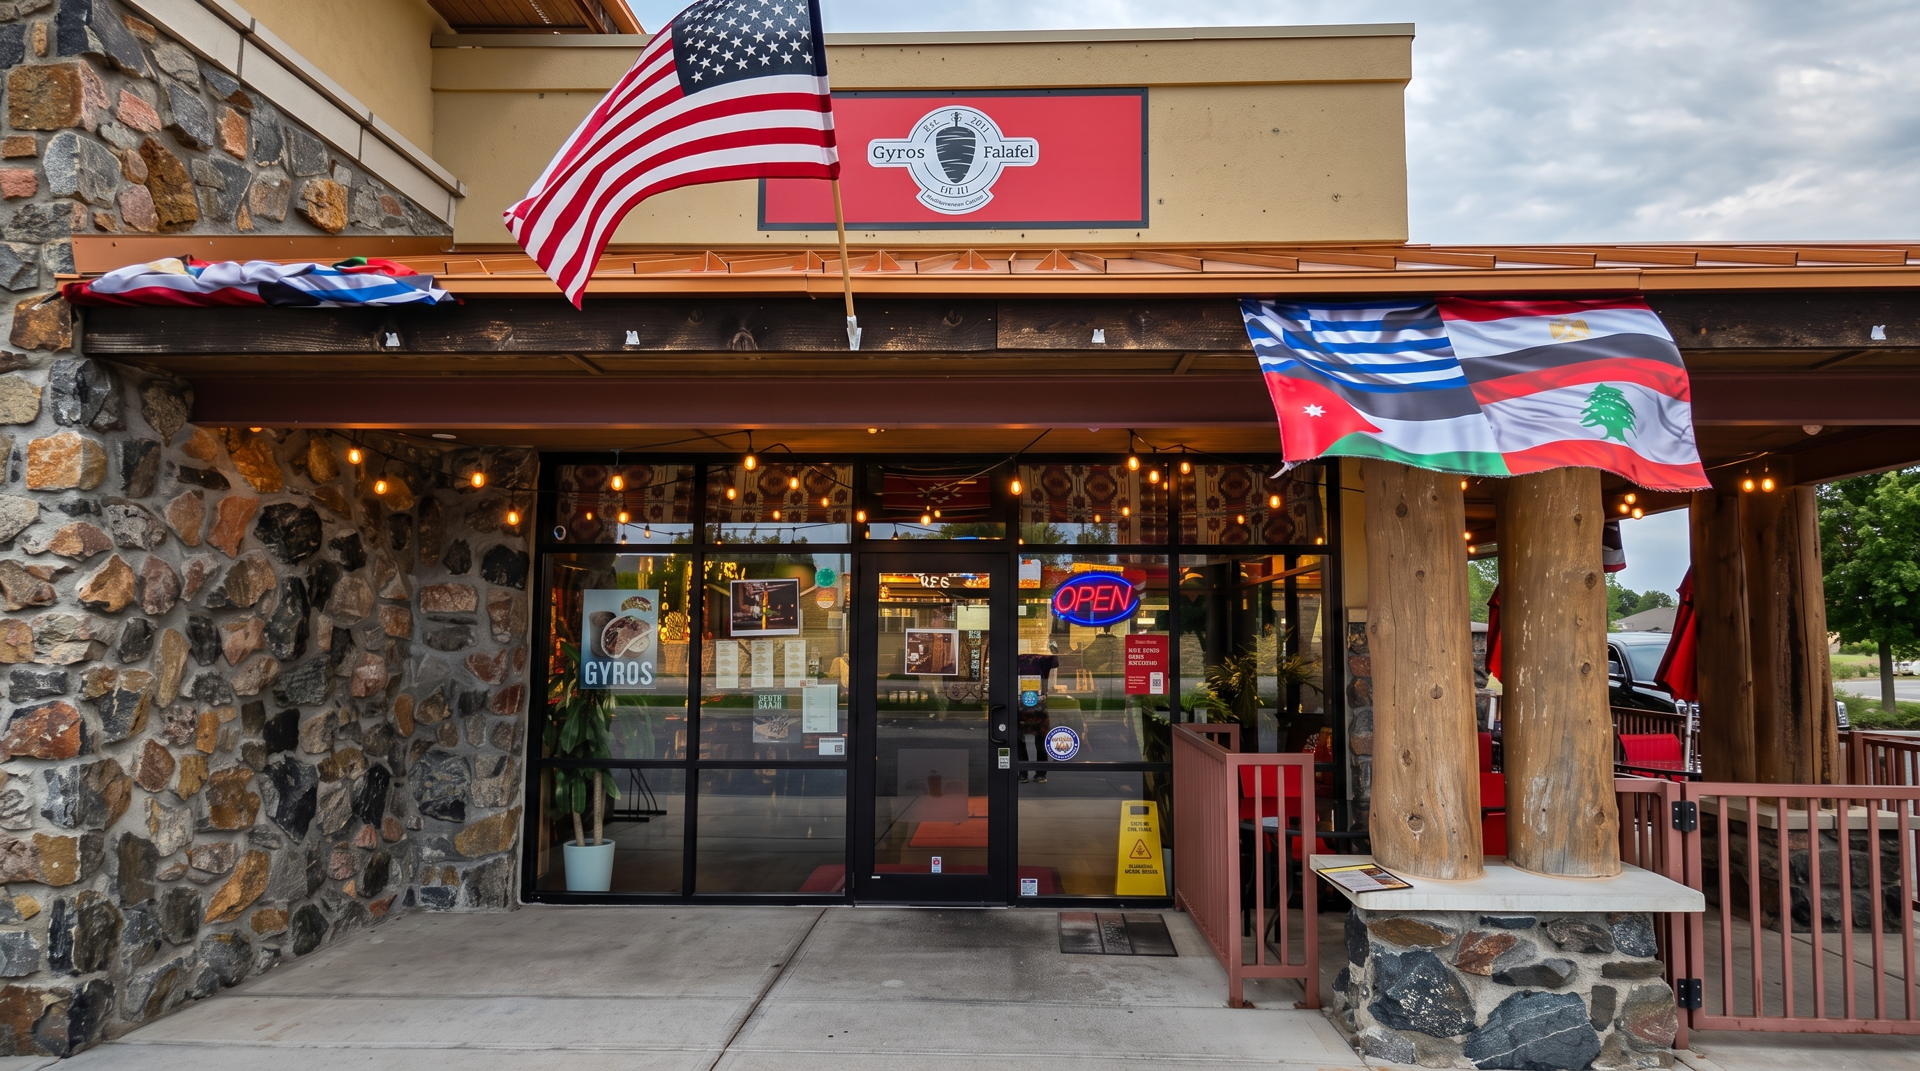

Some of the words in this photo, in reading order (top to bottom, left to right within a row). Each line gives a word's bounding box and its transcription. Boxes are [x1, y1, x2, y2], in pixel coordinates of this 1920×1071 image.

[970, 117, 990, 133] 2011
[873, 145, 925, 162] Gyros
[983, 144, 1034, 158] Falafel
[1055, 585, 1133, 612] OPEN
[585, 661, 653, 685] GYROS
